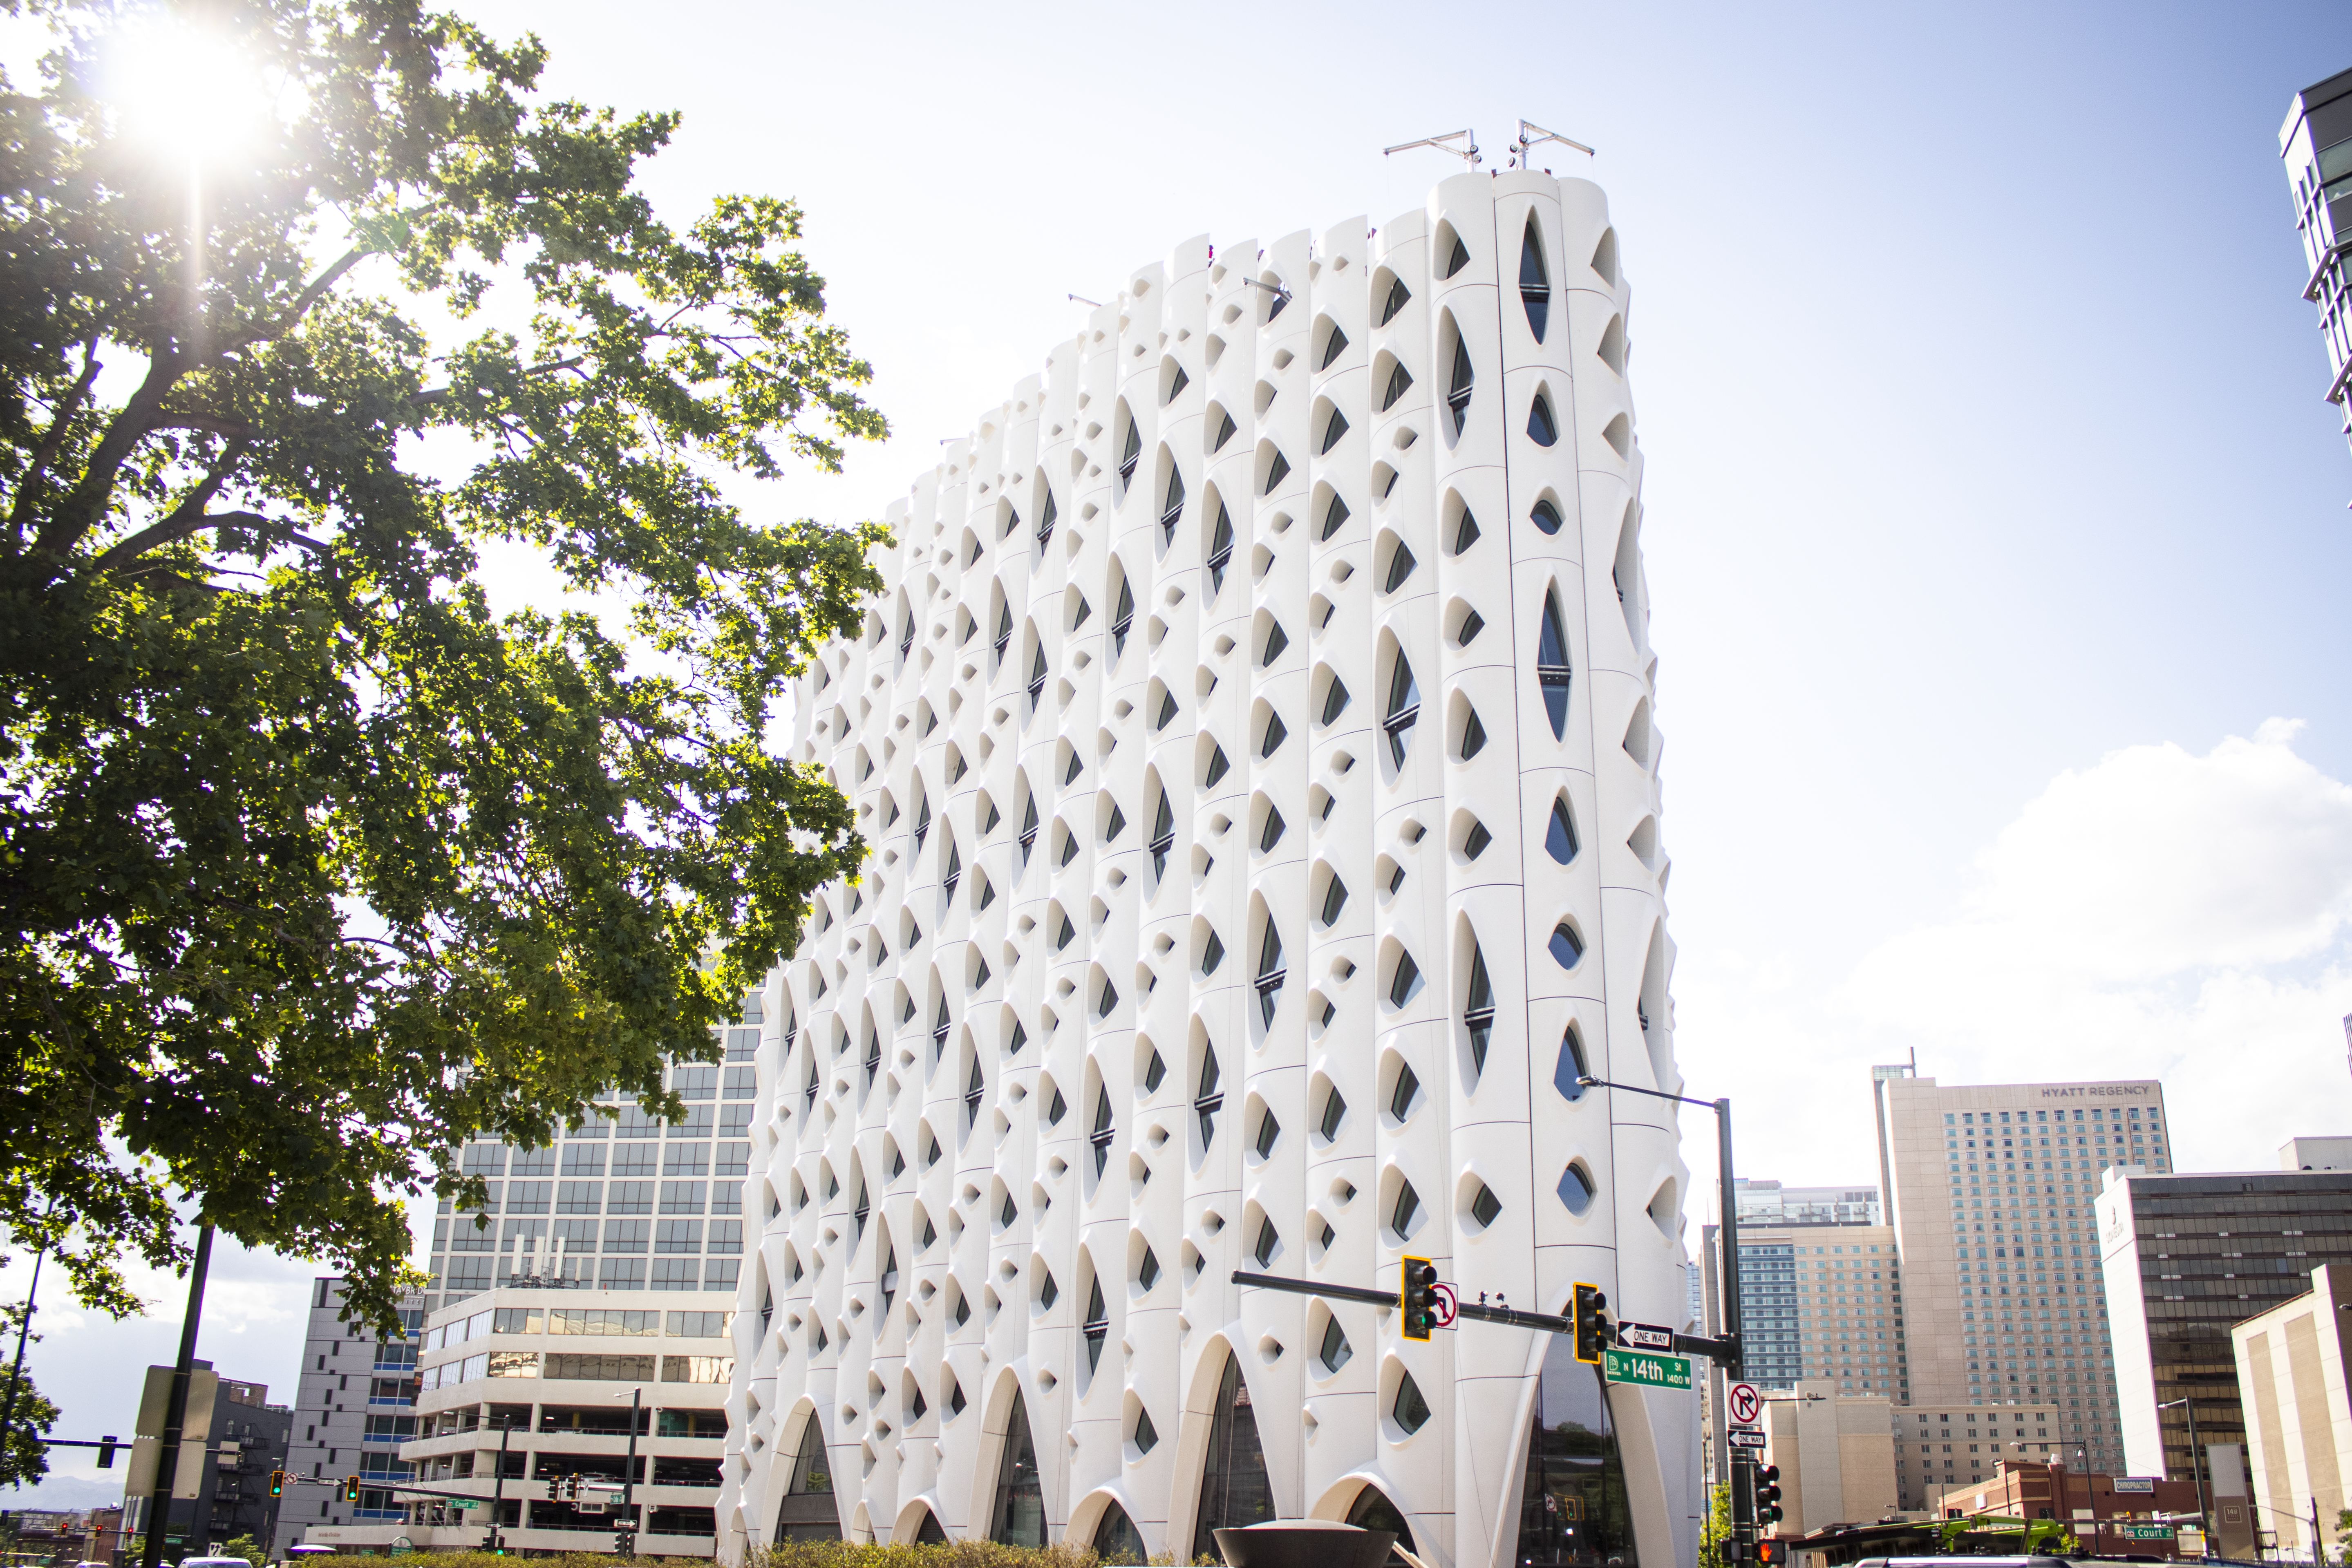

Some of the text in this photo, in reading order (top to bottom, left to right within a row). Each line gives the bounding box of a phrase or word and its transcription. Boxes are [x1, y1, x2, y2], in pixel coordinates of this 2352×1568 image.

[2041, 1085, 2149, 1097] HYATT REGENCY
[1634, 1331, 1667, 1344] ONE WAY
[1623, 1358, 1682, 1381] N 14th St
[1667, 1373, 1691, 1385] 1400 W
[2116, 1481, 2151, 1490] CHIROPRACTOR
[2138, 1529, 2162, 1537] Court
